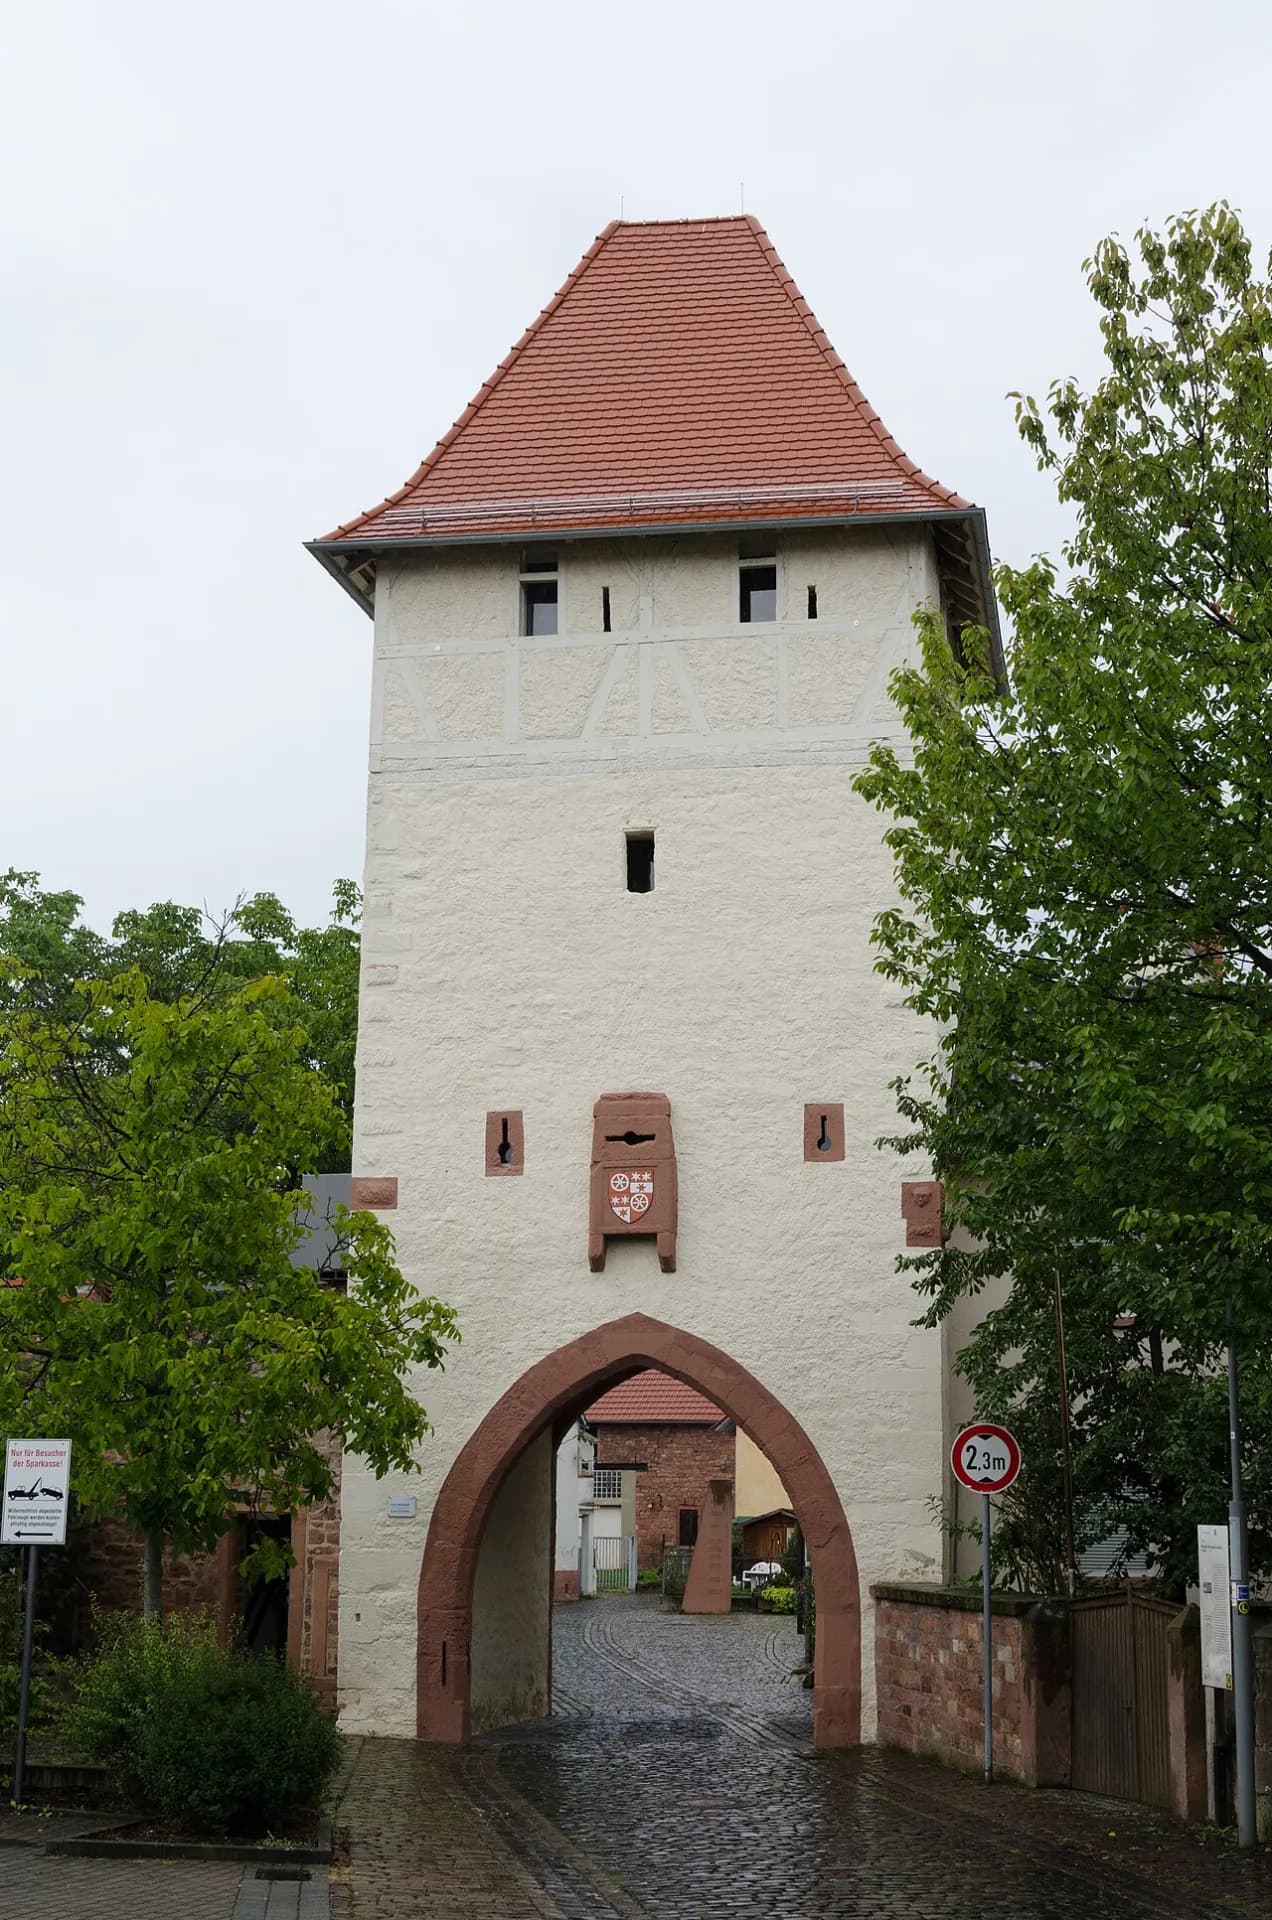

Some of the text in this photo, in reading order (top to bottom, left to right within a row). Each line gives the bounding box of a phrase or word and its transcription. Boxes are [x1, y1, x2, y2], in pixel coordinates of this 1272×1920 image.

[11, 1449, 66, 1457] Nur für Besucher
[966, 1445, 1005, 1472] 2,3m
[25, 1460, 63, 1469] Sparkasse!
